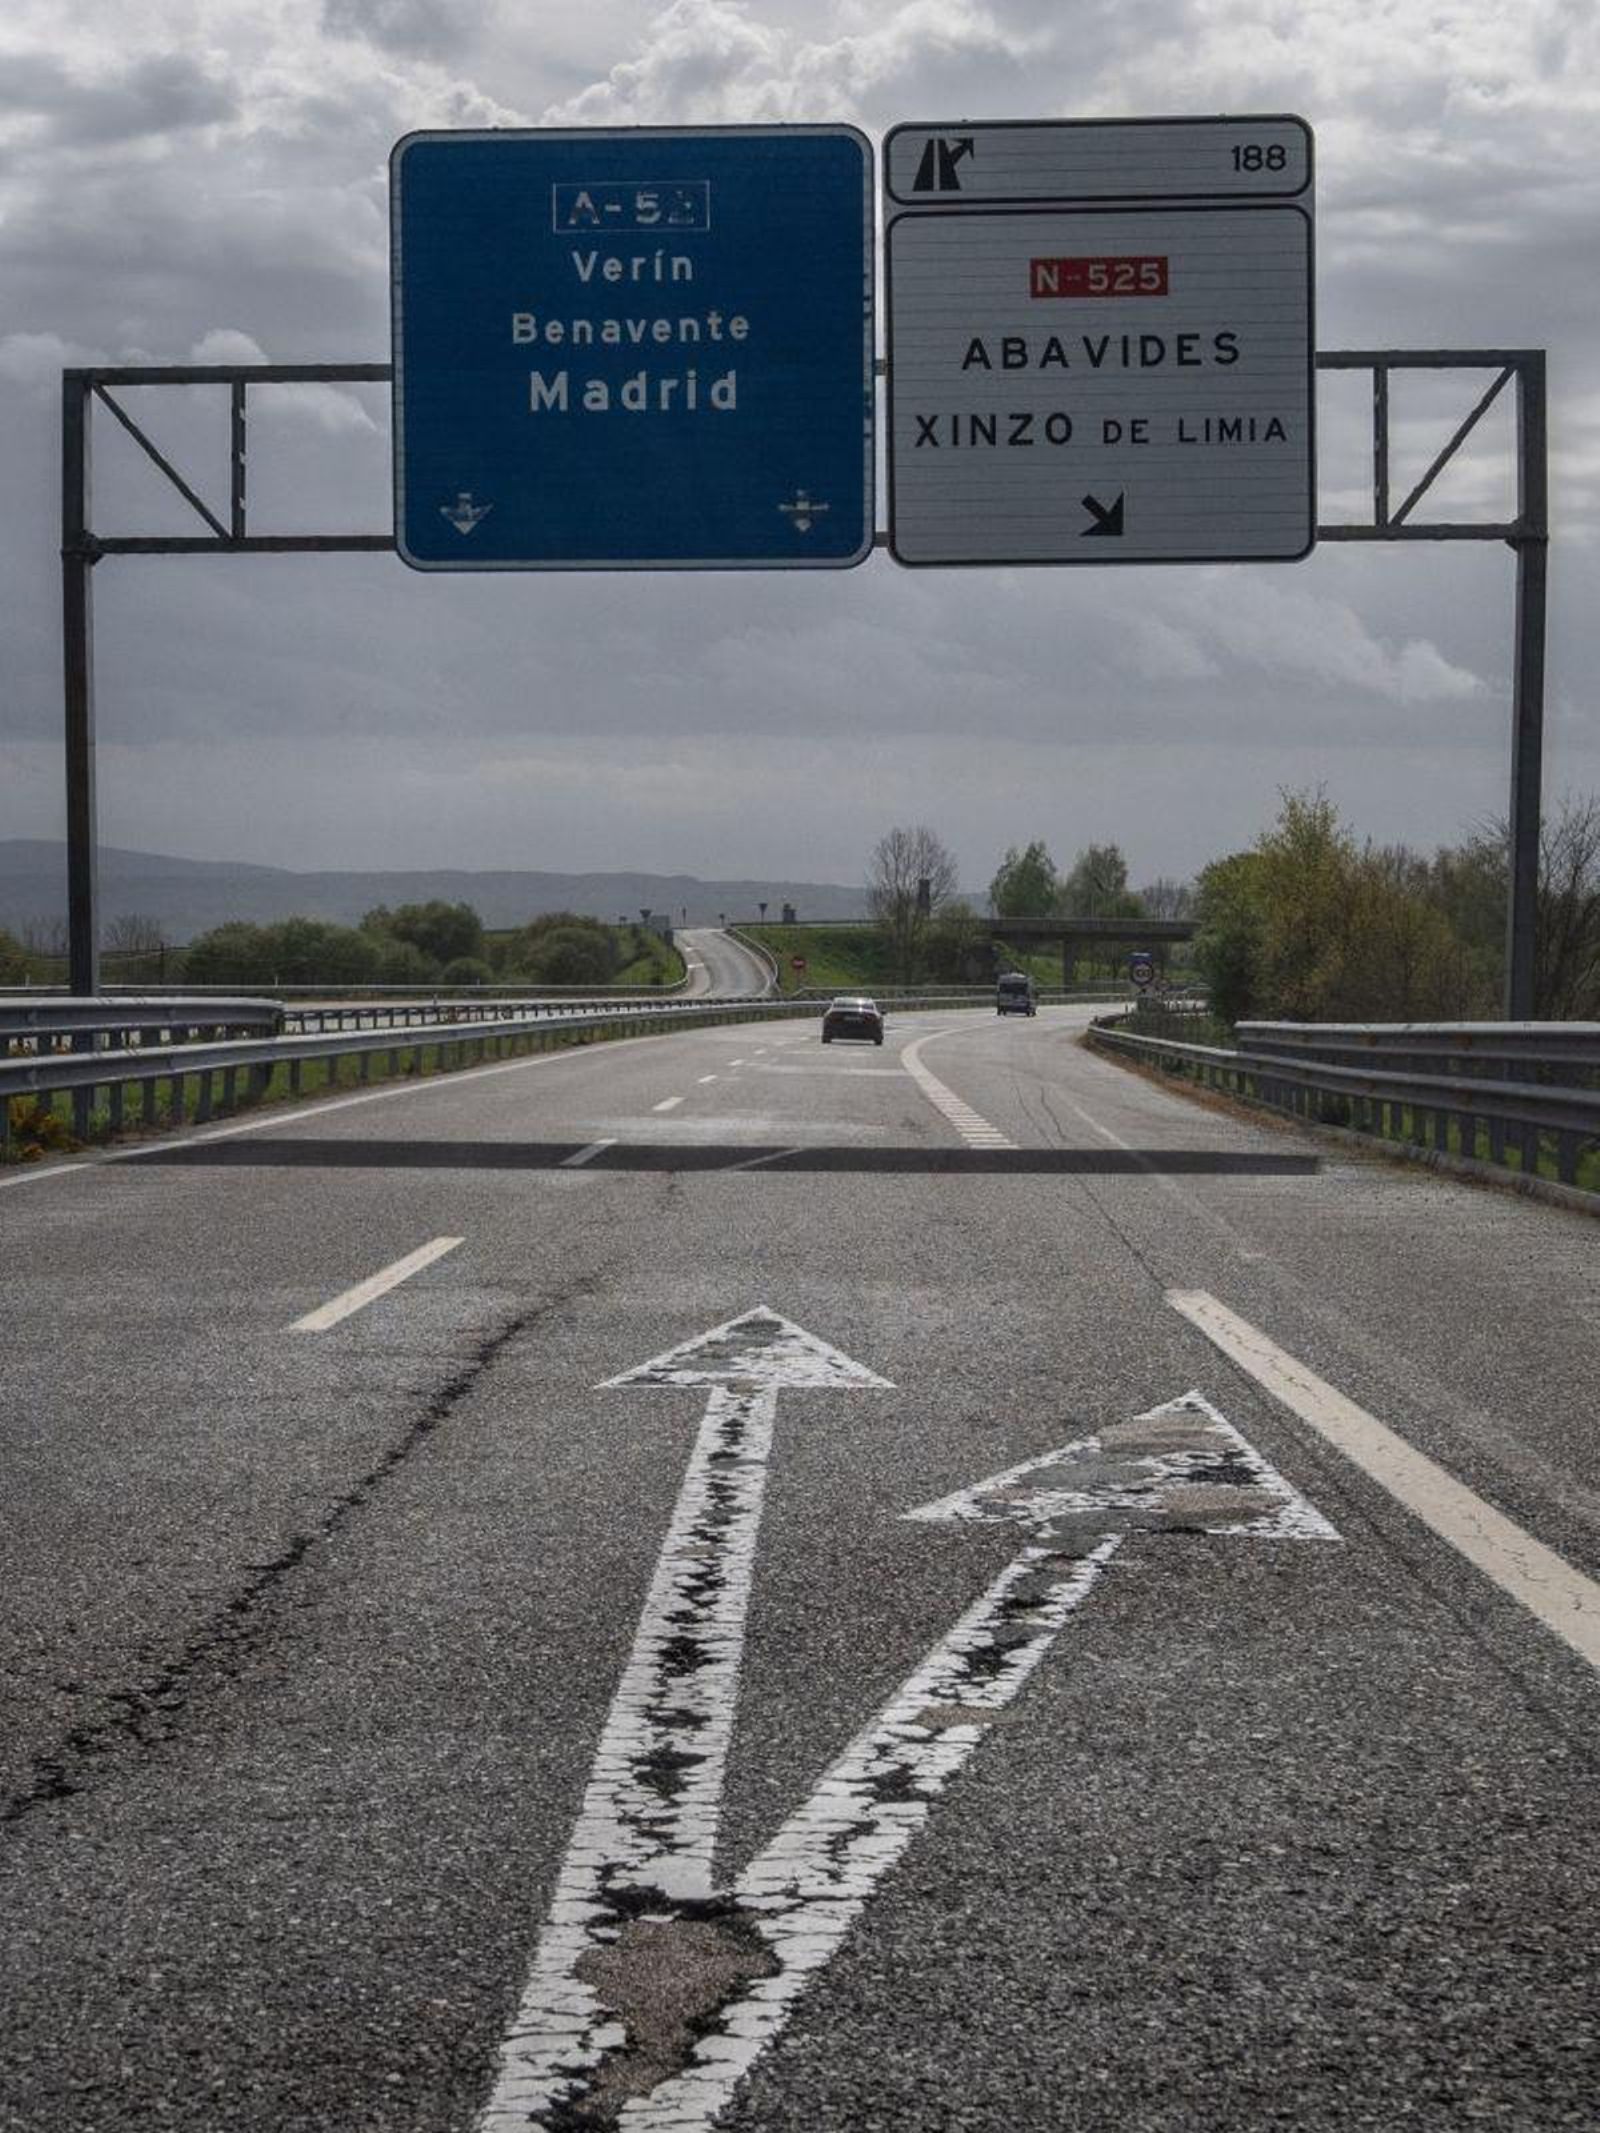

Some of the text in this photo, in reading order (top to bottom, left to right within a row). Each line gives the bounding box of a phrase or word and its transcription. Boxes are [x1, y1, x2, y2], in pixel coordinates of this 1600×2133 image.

[1231, 144, 1287, 172] 188
[572, 249, 693, 282] Verín
[1037, 262, 1161, 292] N-525
[512, 311, 749, 344] Benavente
[961, 332, 1240, 371] ABAVIDES
[530, 369, 737, 412] Madrid
[915, 412, 1287, 448] XINZO DE LIMIA
